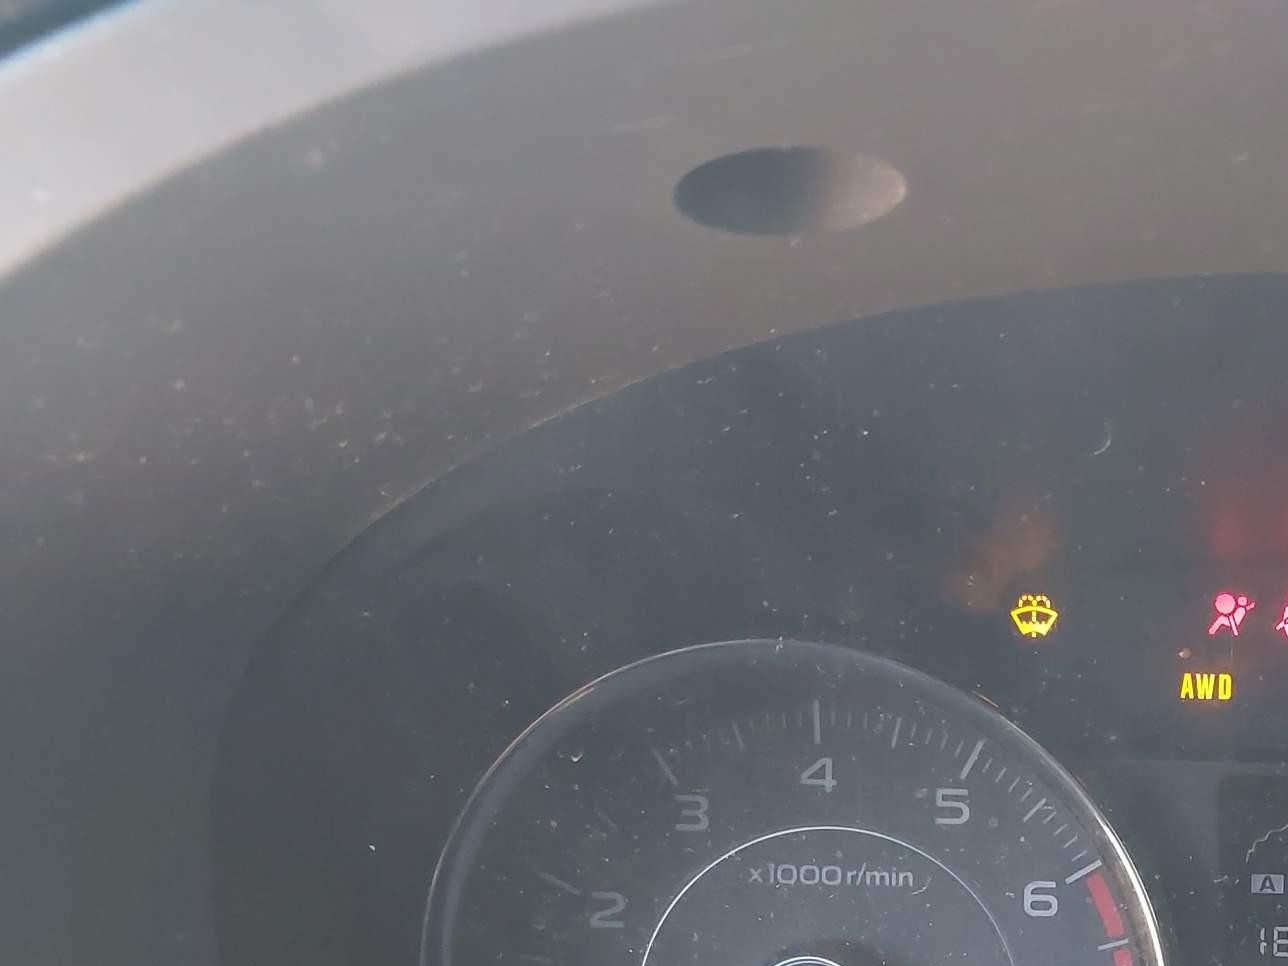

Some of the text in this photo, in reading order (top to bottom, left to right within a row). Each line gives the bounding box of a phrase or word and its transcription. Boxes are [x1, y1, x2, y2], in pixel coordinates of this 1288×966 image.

[1180, 672, 1233, 701] AWD
[801, 758, 837, 791] 4
[675, 795, 710, 831] 3
[935, 788, 971, 825] 5
[845, 862, 914, 888] r/min
[590, 892, 626, 929] 2
[1024, 881, 1059, 918] 6
